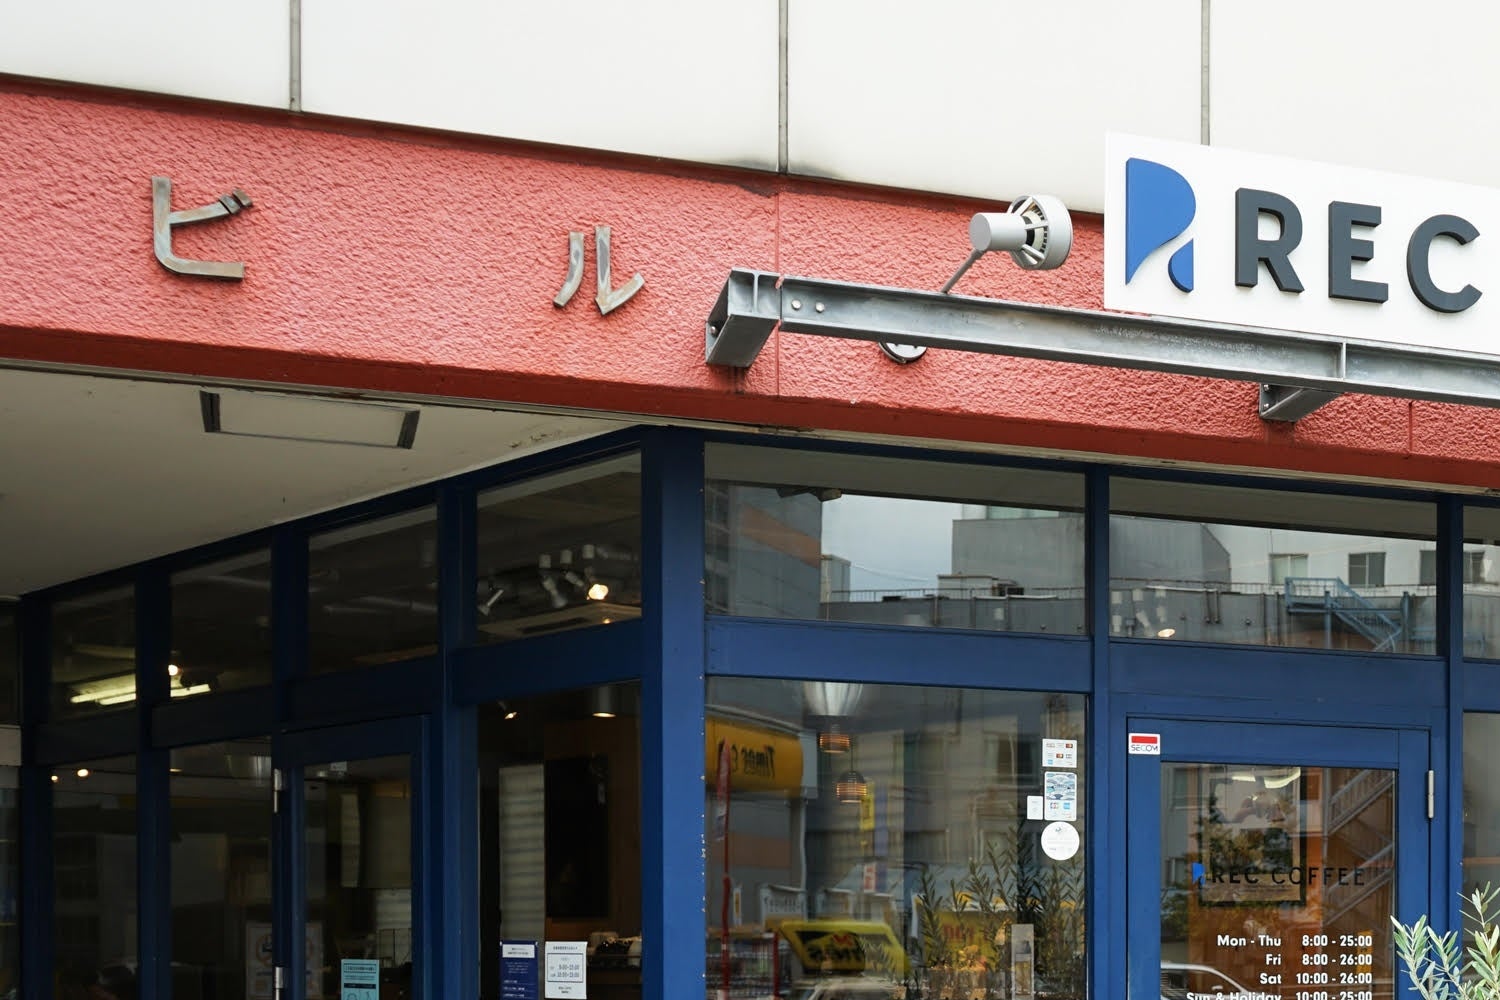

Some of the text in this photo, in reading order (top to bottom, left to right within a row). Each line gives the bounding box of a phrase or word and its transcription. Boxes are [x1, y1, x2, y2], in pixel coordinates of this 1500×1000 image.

[1234, 187, 1483, 314] REC
[1130, 744, 1159, 752] SECOM
[1212, 867, 1366, 886] REC COFFEE
[1217, 935, 1247, 947] Mon
[1258, 935, 1282, 947] Thu
[1302, 935, 1328, 947] 8:00
[1339, 935, 1373, 947] 25:00
[1265, 954, 1282, 966] Fri
[1302, 954, 1328, 966] 8:00
[1339, 954, 1373, 966] 26:00
[1259, 973, 1282, 985] Sat
[1296, 973, 1328, 985] 10:00
[1339, 973, 1373, 985] 26:00
